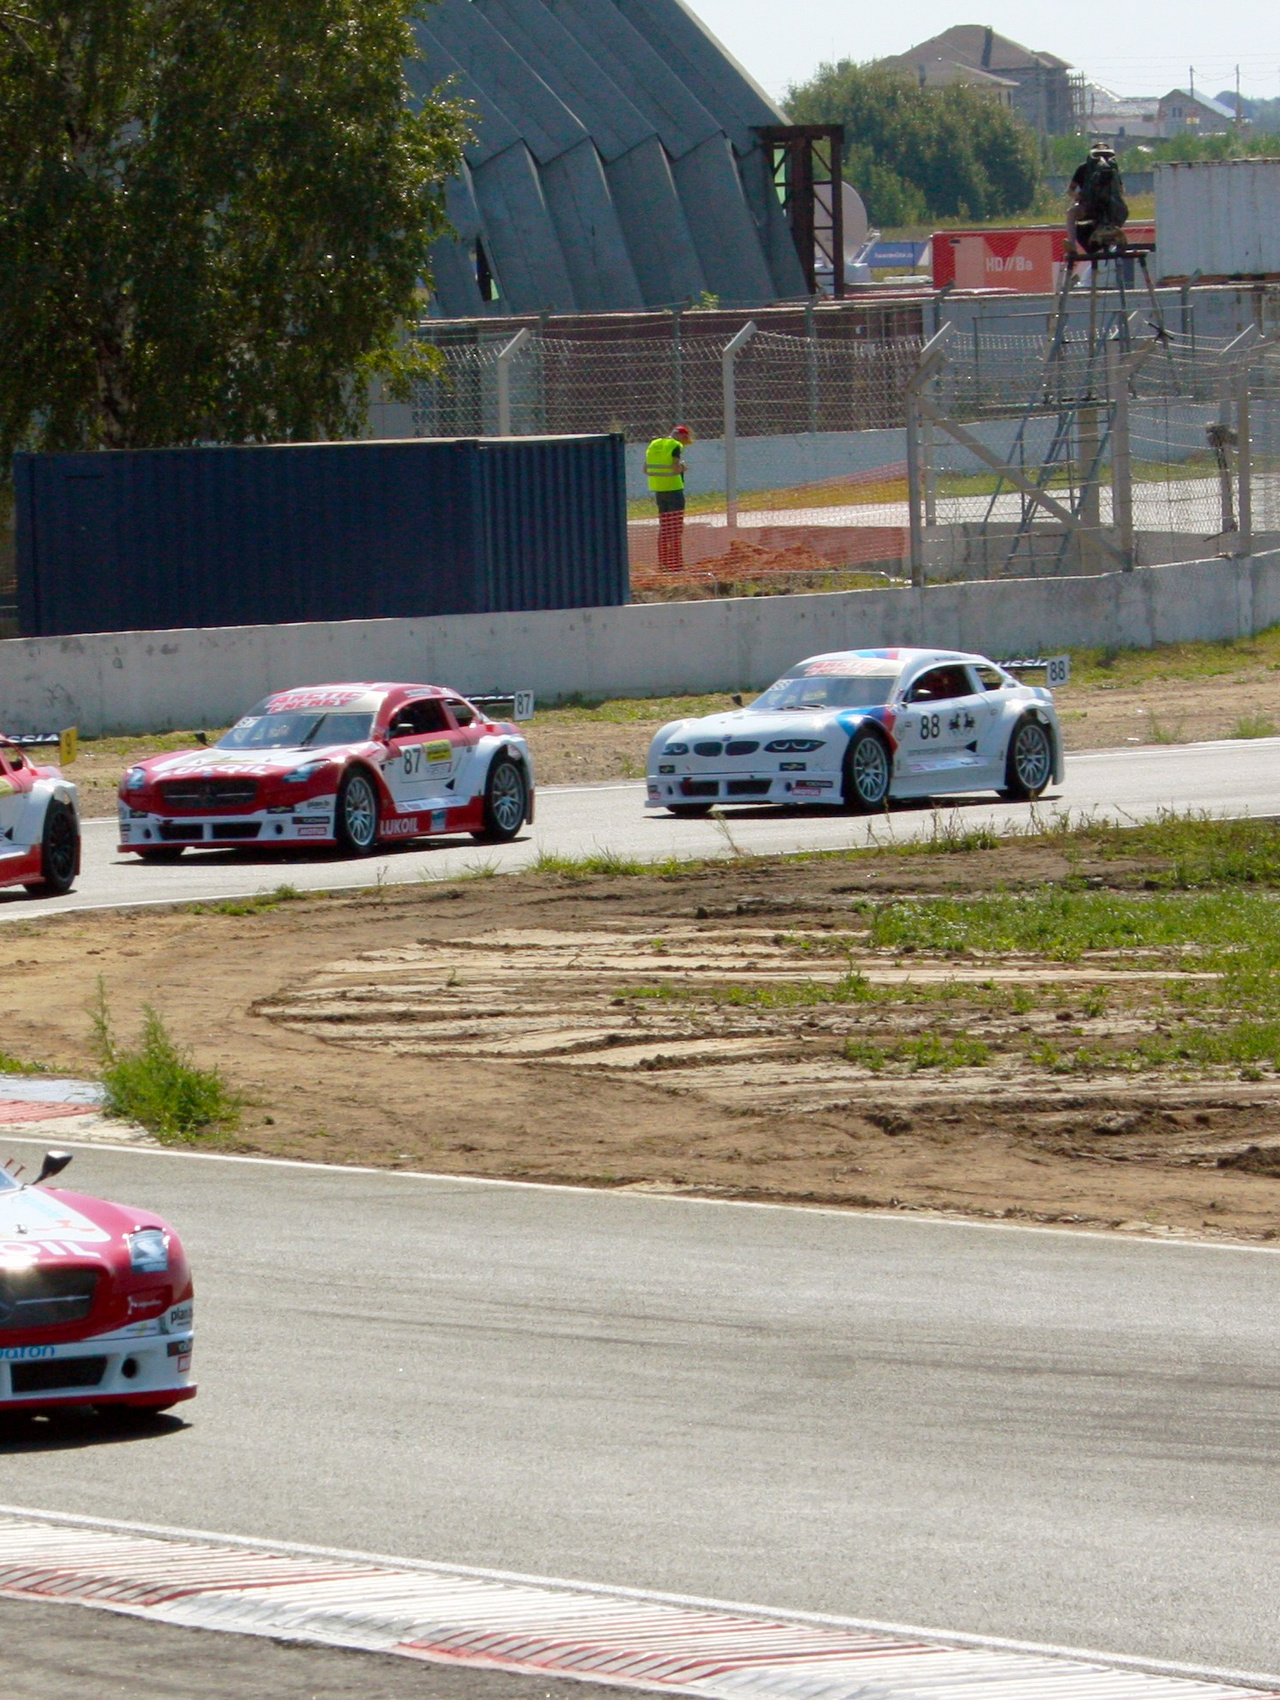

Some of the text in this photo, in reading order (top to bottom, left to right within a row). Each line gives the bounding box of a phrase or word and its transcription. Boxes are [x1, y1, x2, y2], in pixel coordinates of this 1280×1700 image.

[1050, 660, 1065, 681] 88
[269, 692, 364, 706] ARCTIC
[518, 693, 531, 715] 87
[920, 714, 940, 740] 88
[65, 733, 72, 755] 9
[404, 748, 421, 774] 87
[380, 818, 418, 835] LUKOIL
